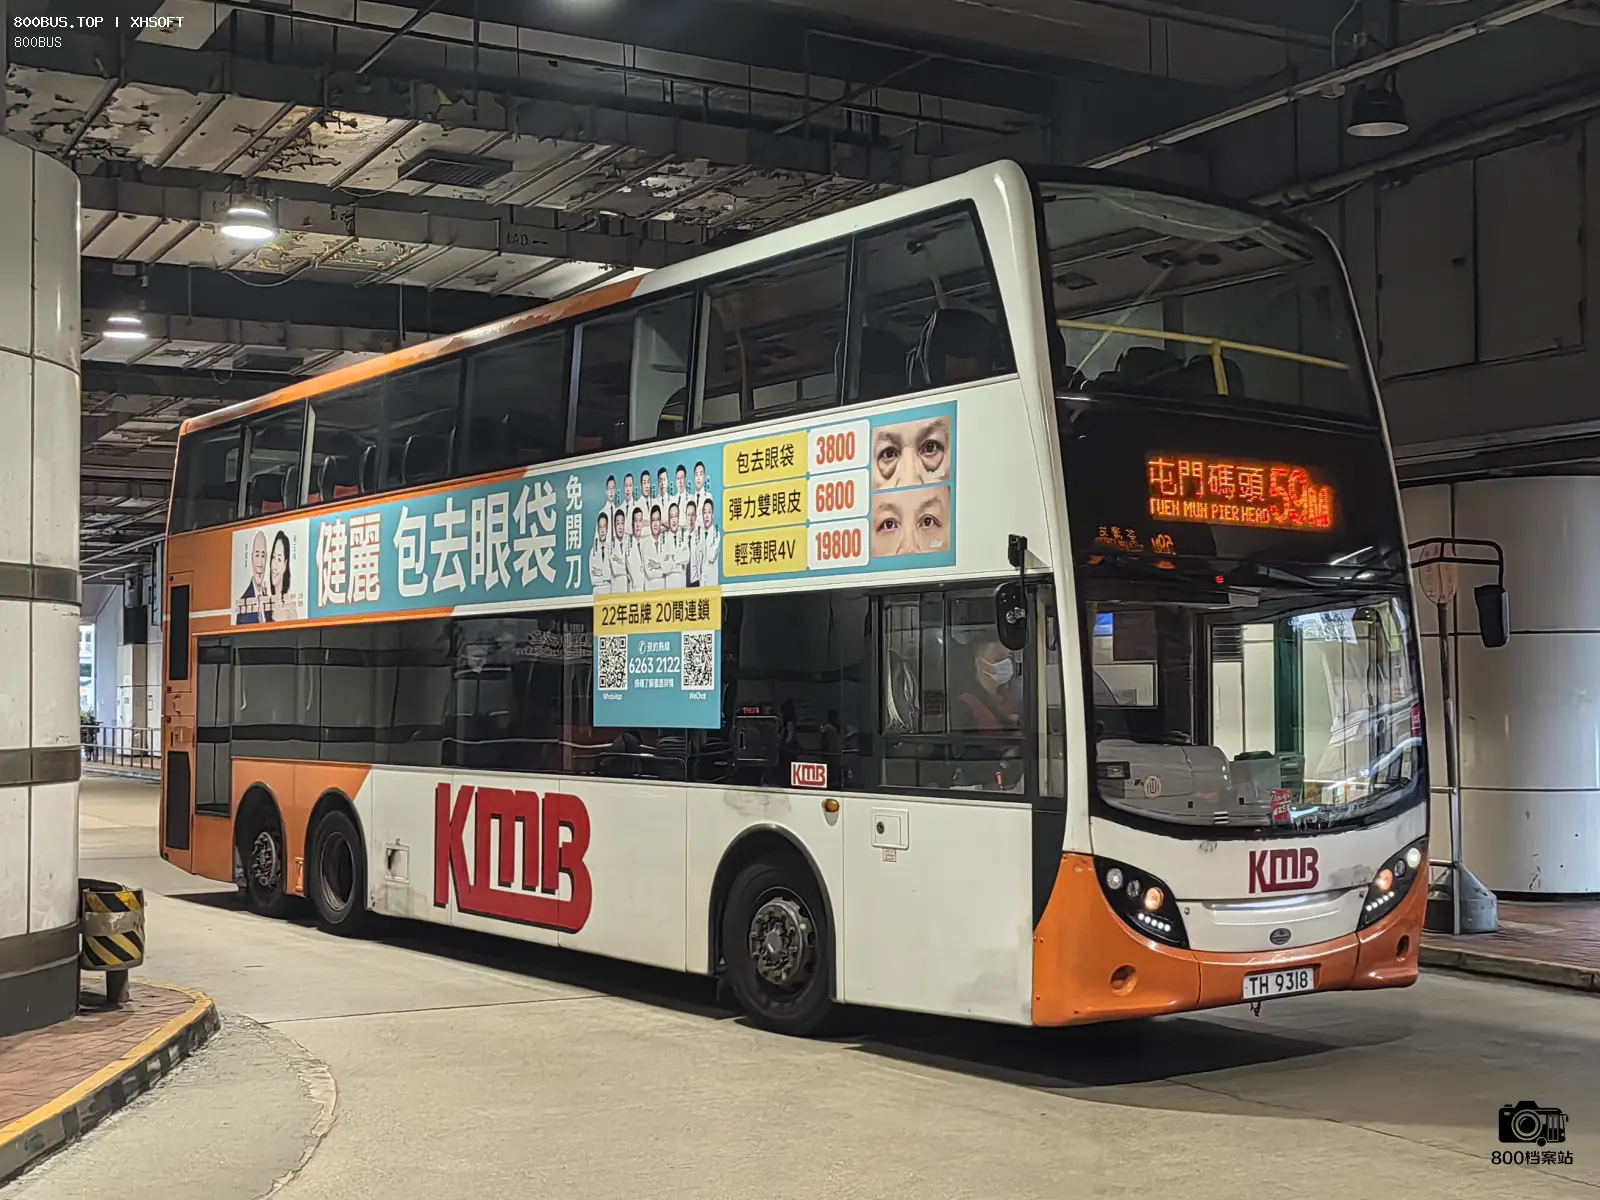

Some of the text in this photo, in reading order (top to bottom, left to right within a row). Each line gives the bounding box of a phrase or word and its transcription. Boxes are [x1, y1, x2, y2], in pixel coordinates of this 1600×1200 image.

[736, 444, 795, 474] 包去眼袋
[815, 431, 856, 466] 3800
[815, 479, 855, 513] 6800
[1148, 457, 1265, 502] 屯門碼頭
[729, 489, 802, 522] 彈力雙眼皮
[1150, 498, 1270, 524] TUEN MUN PIER HEAD
[1269, 466, 1330, 528] 59M
[315, 480, 557, 608] 健麗 包去眼袋
[565, 475, 583, 590] 免開刀
[815, 528, 862, 561] 19800
[734, 539, 797, 566] 輕薄眼4V
[601, 599, 711, 626] 22年品牌 20間連鎖
[629, 656, 681, 674] 6263 2122
[792, 764, 826, 787] KMB
[433, 782, 593, 935] KMB
[1249, 847, 1320, 894] KMB
[1249, 971, 1308, 996] TH 9318
